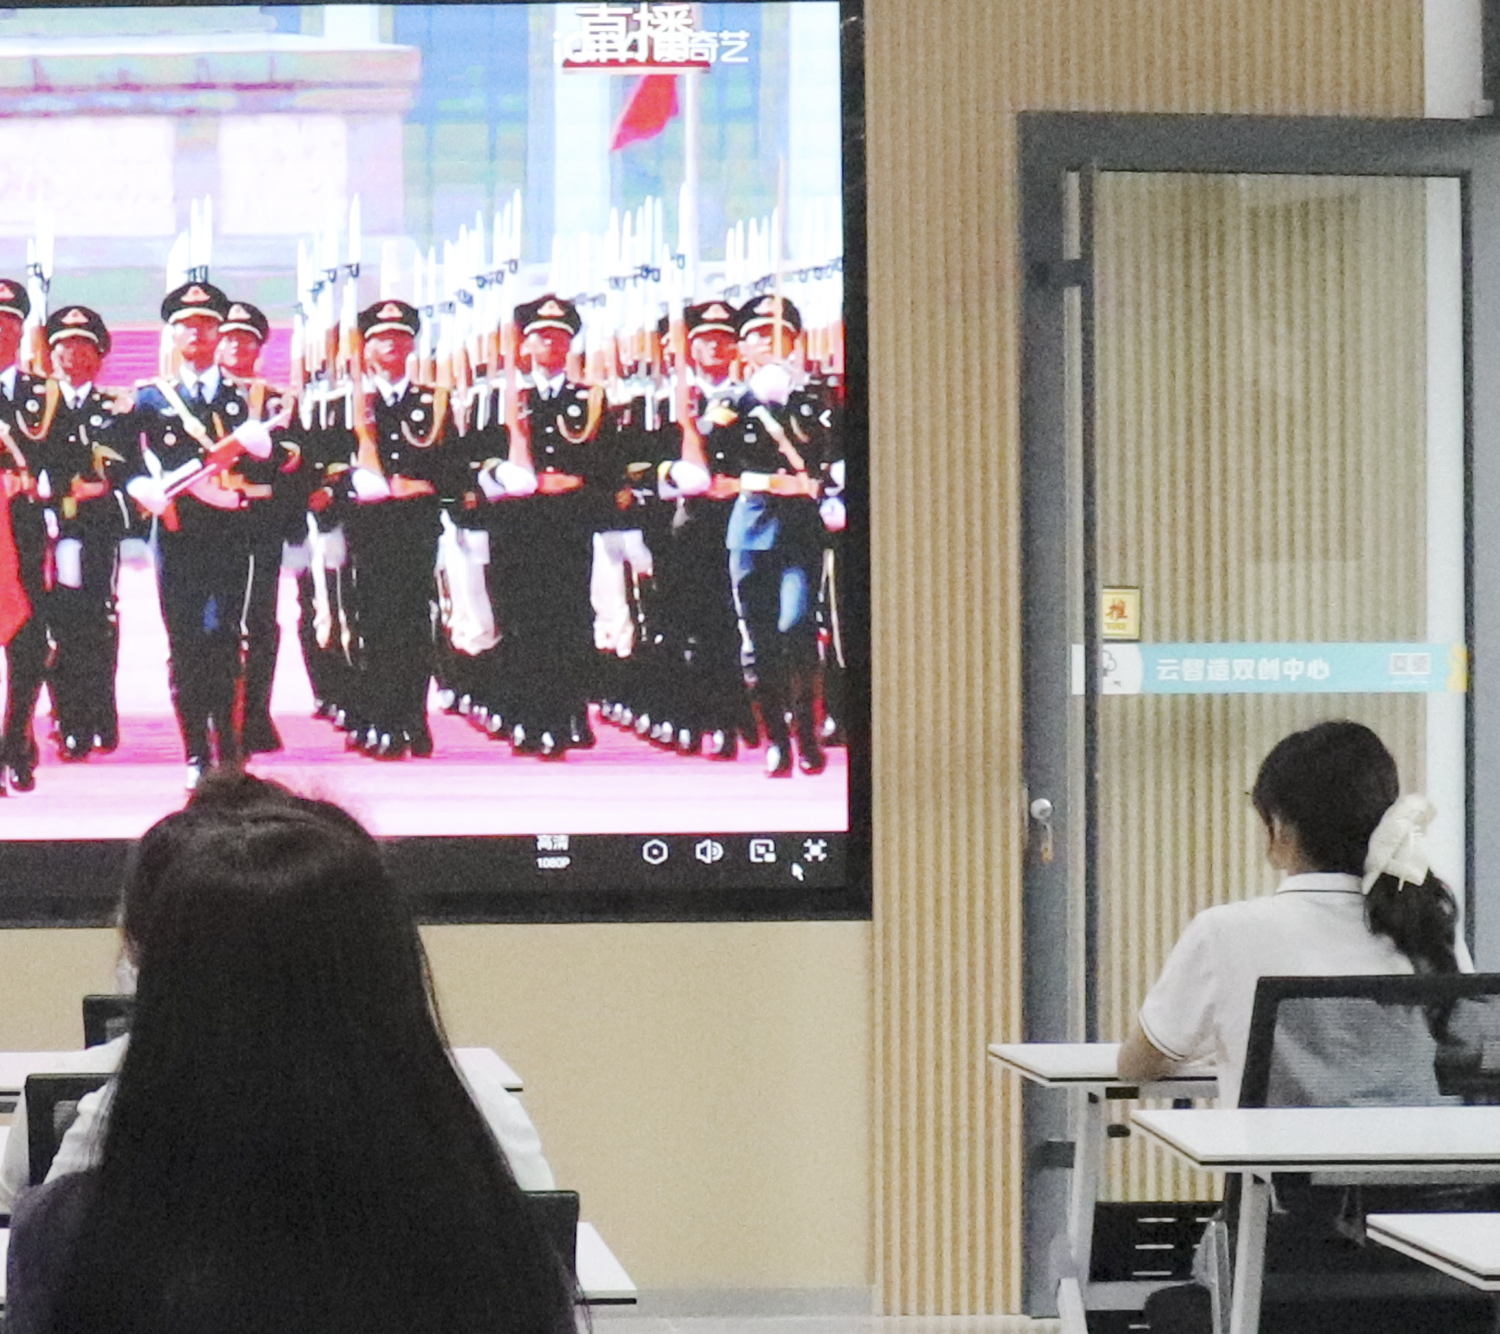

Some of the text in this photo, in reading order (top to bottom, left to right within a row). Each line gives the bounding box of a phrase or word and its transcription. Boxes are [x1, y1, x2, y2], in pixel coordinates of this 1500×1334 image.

[575, 3, 694, 63] 直播
[1156, 657, 1331, 682] 云智造双创中心
[536, 856, 571, 869] 1080P
